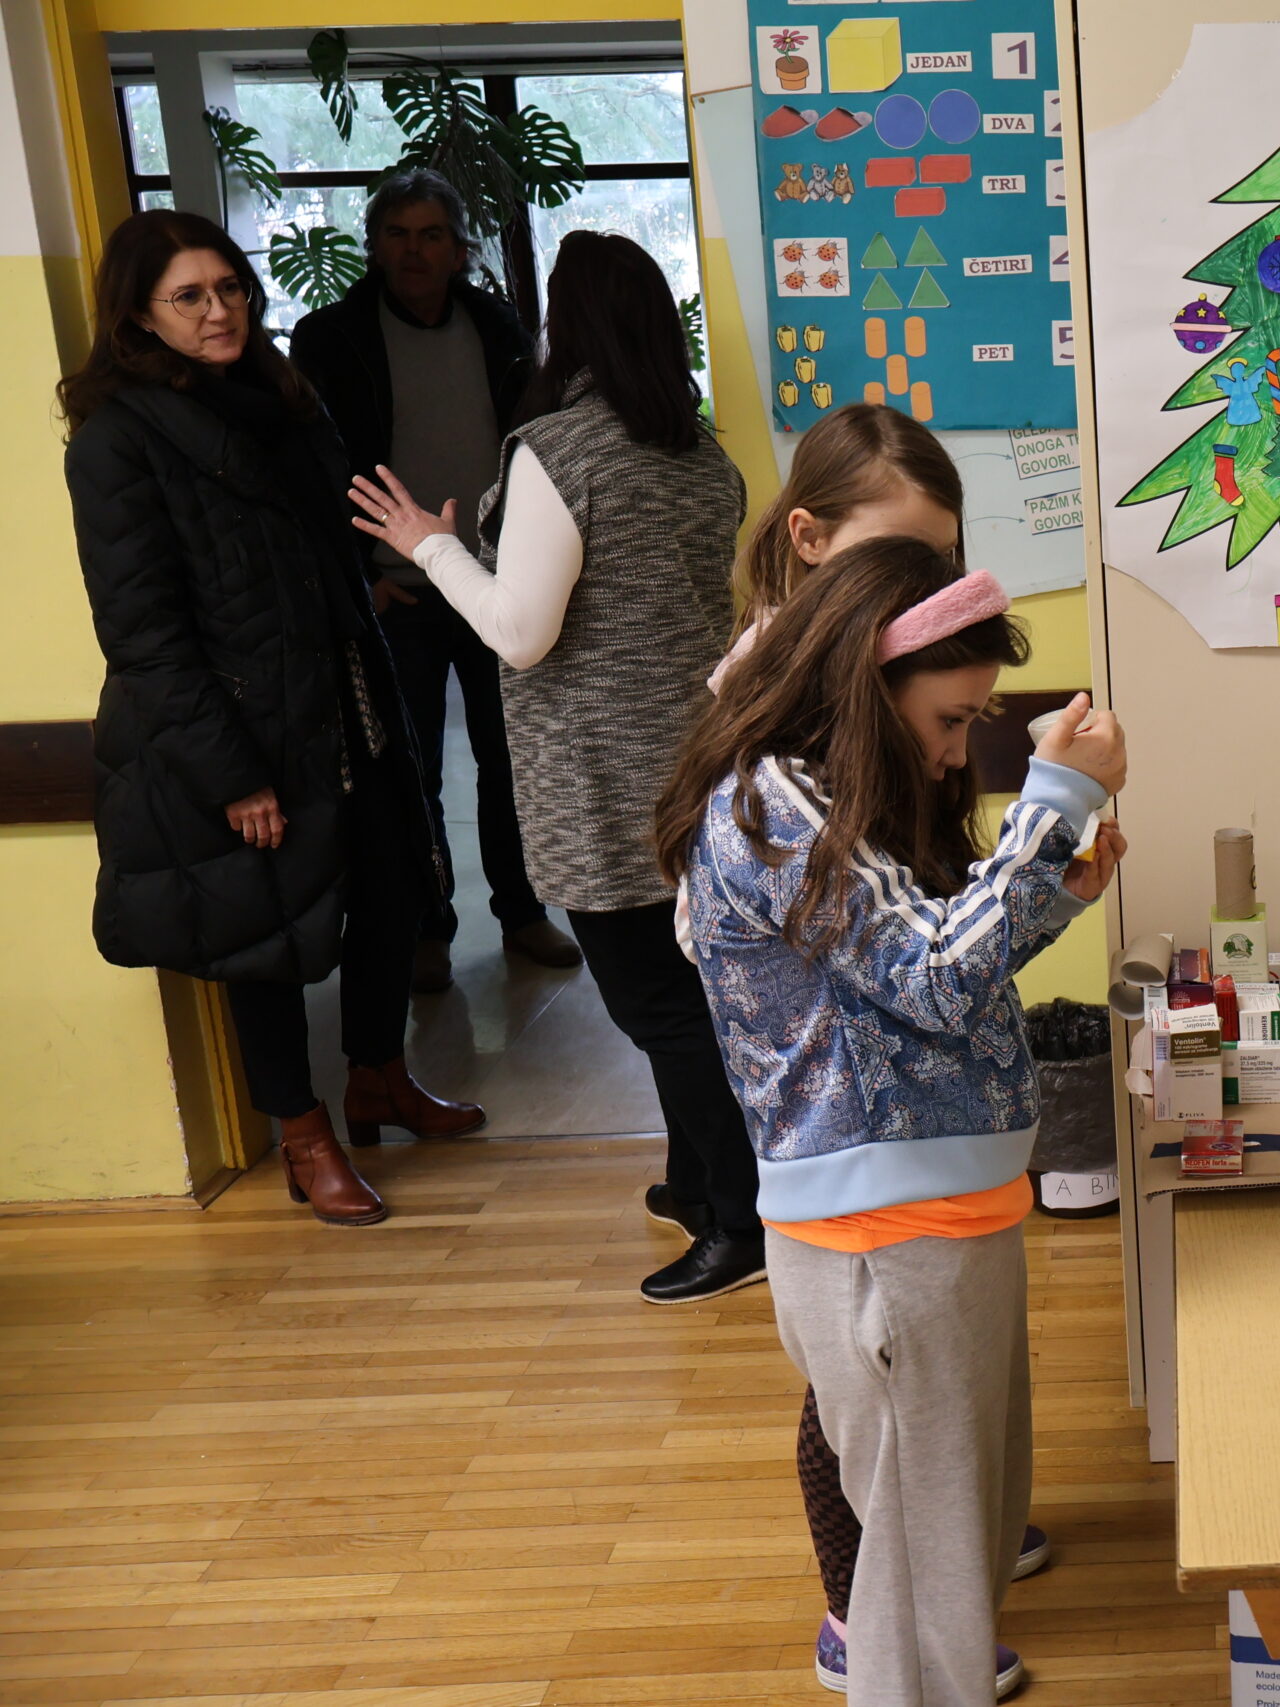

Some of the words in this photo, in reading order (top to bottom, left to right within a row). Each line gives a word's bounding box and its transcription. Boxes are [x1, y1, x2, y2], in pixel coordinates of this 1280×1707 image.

[910, 53, 968, 70] JEDAN
[1006, 40, 1029, 75] 1
[991, 117, 1027, 131] DVA
[987, 177, 1018, 191] TRI
[968, 256, 1028, 274] ČETIRI
[977, 346, 1010, 360] PET
[1016, 437, 1064, 457] ONOGA
[1021, 453, 1075, 474] GOVORI.
[1030, 495, 1069, 514] PAZIM
[1174, 1037, 1205, 1046] Ventolin
[1056, 1178, 1072, 1197] A
